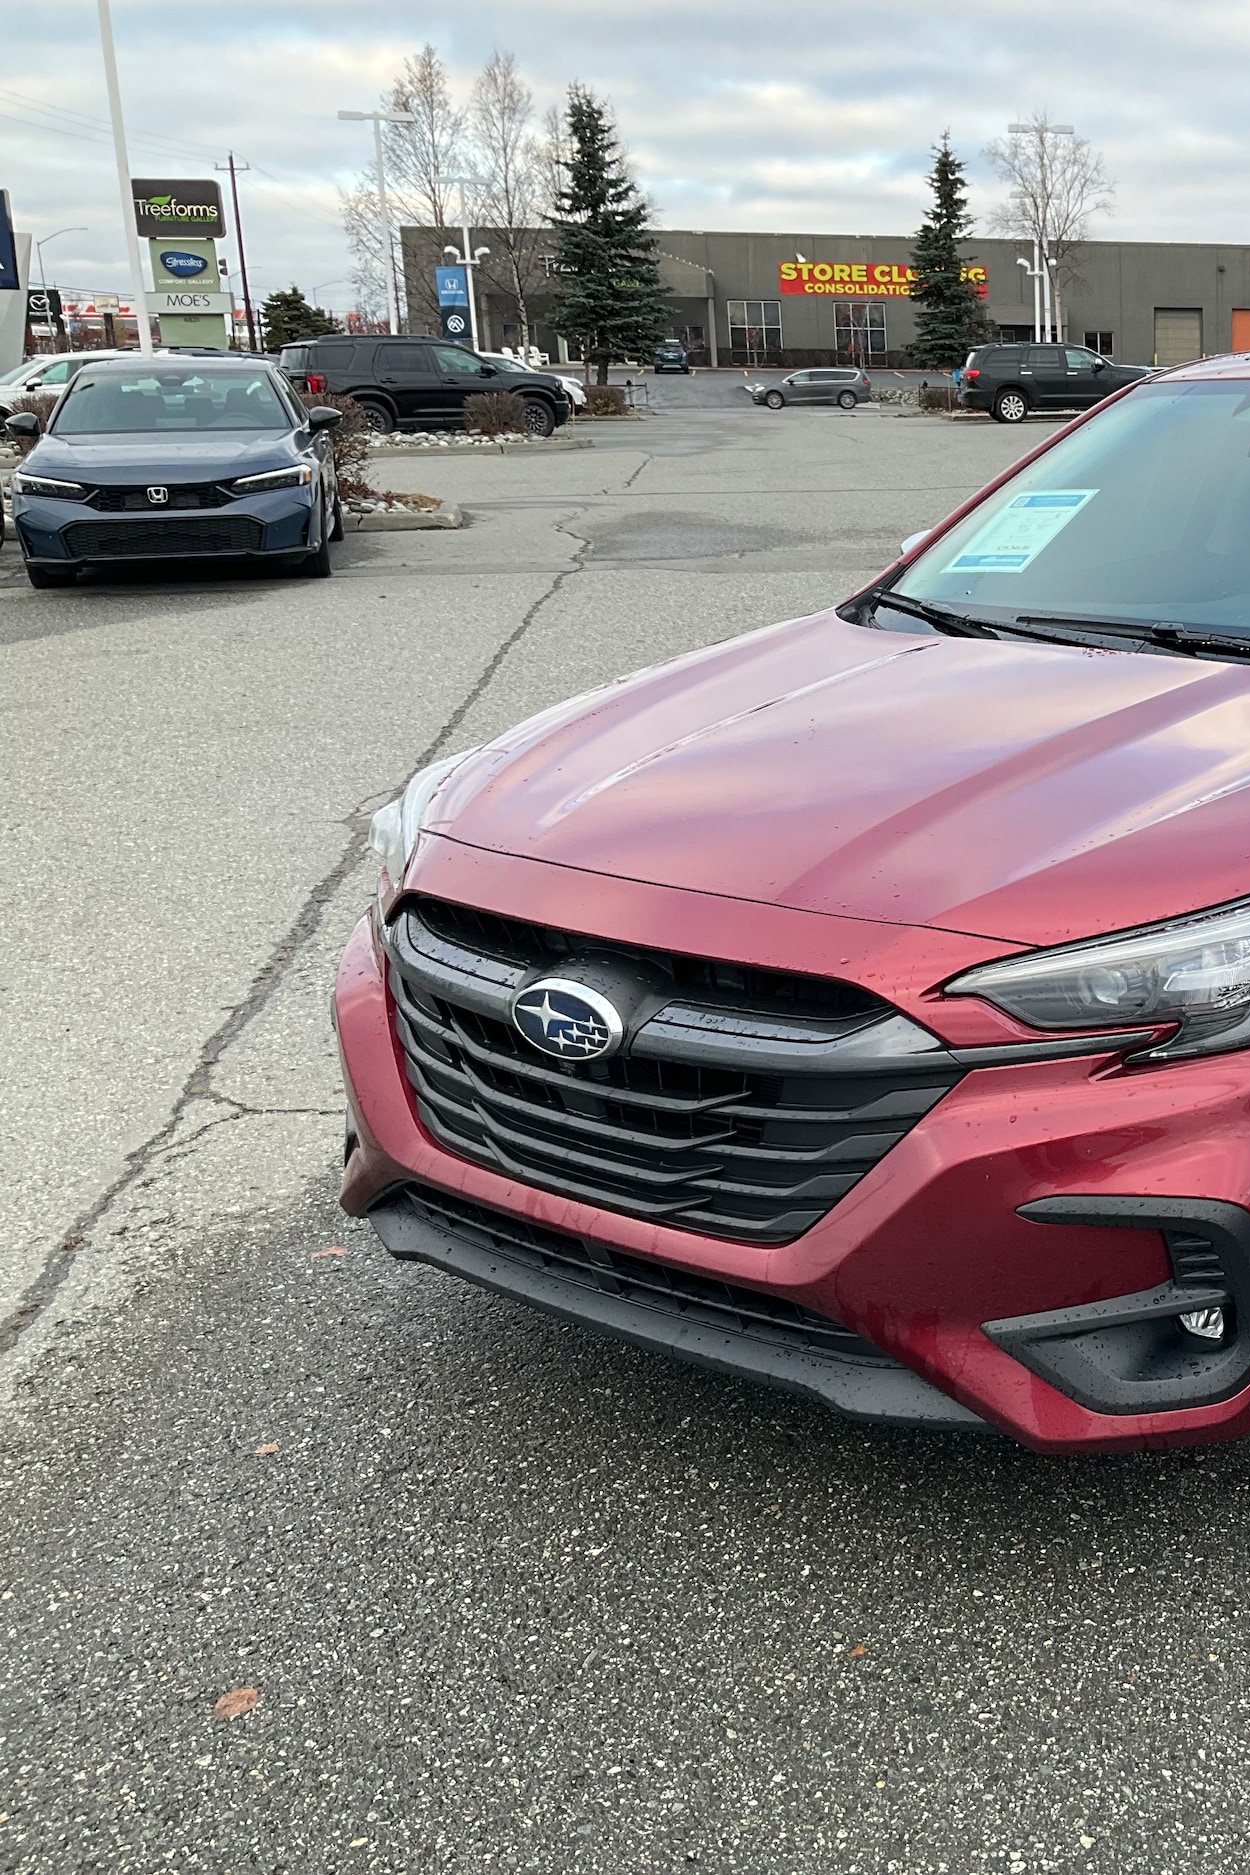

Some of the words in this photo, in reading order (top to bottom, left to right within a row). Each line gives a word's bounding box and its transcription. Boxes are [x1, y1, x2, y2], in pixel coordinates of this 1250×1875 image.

[134, 199, 218, 217] Treeforms
[154, 214, 189, 222] FURNITURE
[165, 257, 203, 268] Stressless
[781, 263, 867, 282] STORE
[166, 294, 211, 307] MOE'S
